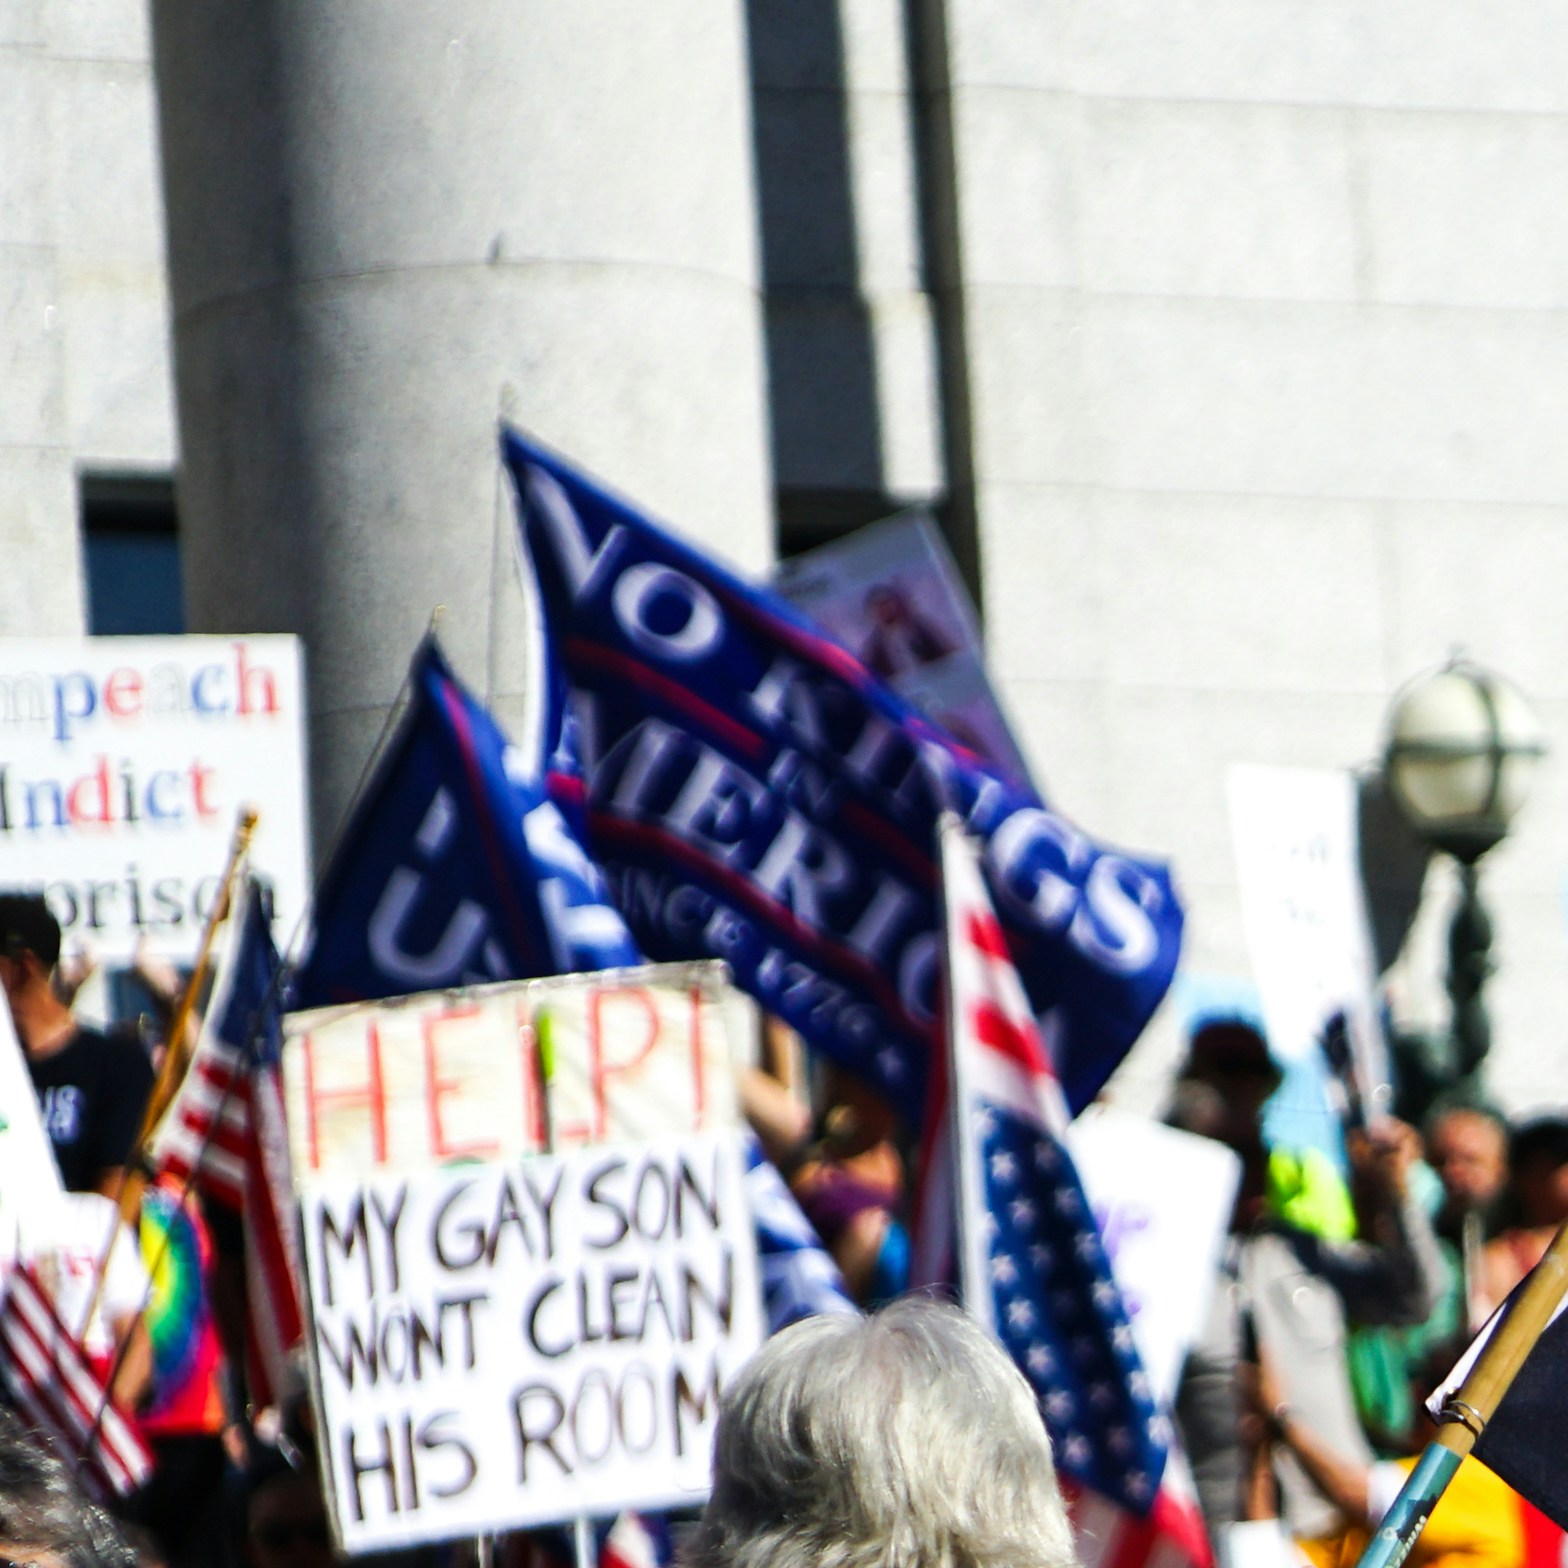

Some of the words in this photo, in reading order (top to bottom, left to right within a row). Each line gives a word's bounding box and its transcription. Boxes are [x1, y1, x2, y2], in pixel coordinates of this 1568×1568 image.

[316, 1180, 409, 1308] MY
[431, 1160, 569, 1272] GAY
[582, 1144, 723, 1249] SON
[523, 1249, 735, 1360] CLEAN
[343, 1410, 480, 1522] HIS
[511, 1359, 722, 1487] ROOM
